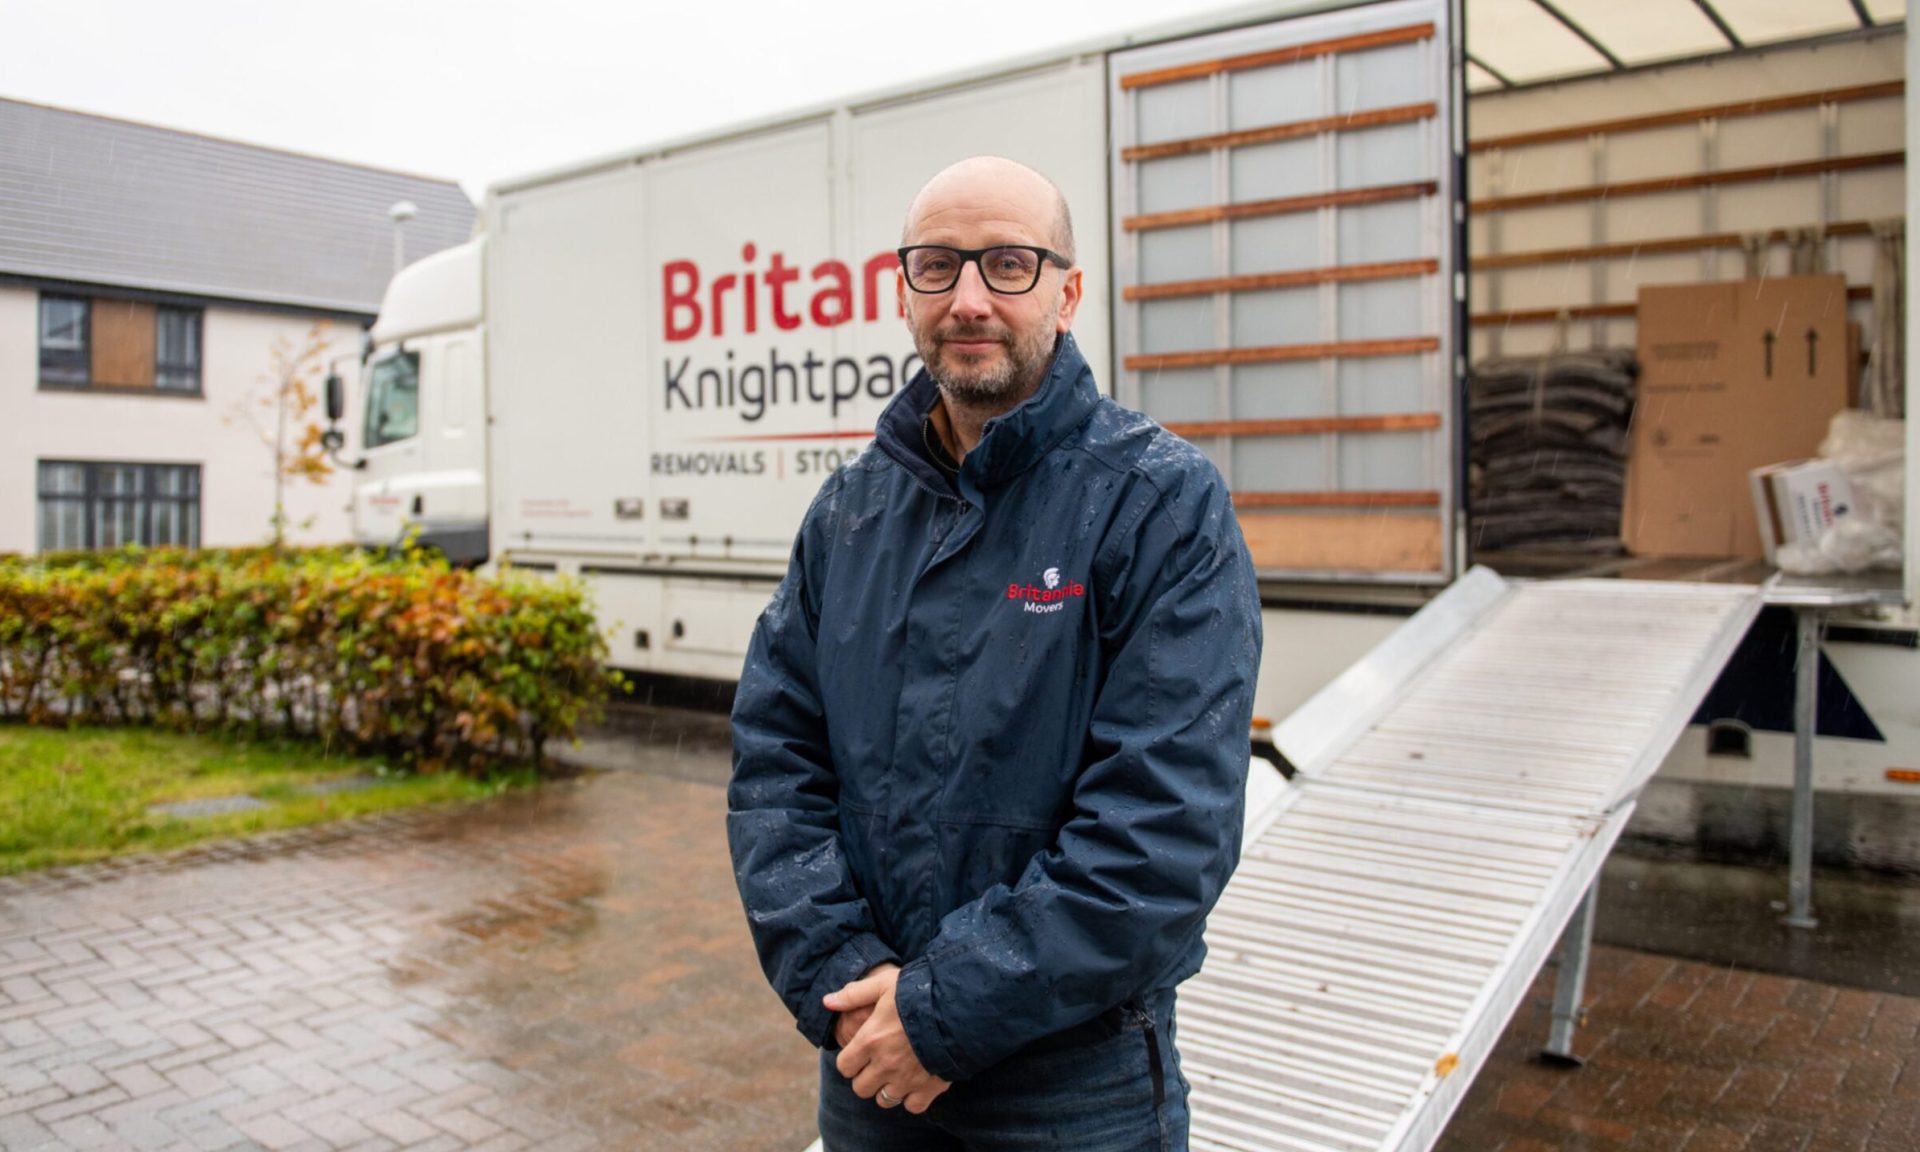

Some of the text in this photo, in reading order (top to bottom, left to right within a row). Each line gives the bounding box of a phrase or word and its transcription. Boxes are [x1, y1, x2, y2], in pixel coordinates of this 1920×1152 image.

[662, 241, 905, 342] Britan
[650, 451, 766, 475] REMOVALS
[1006, 580, 1084, 602] Britannia
[1024, 601, 1063, 613] Movers
